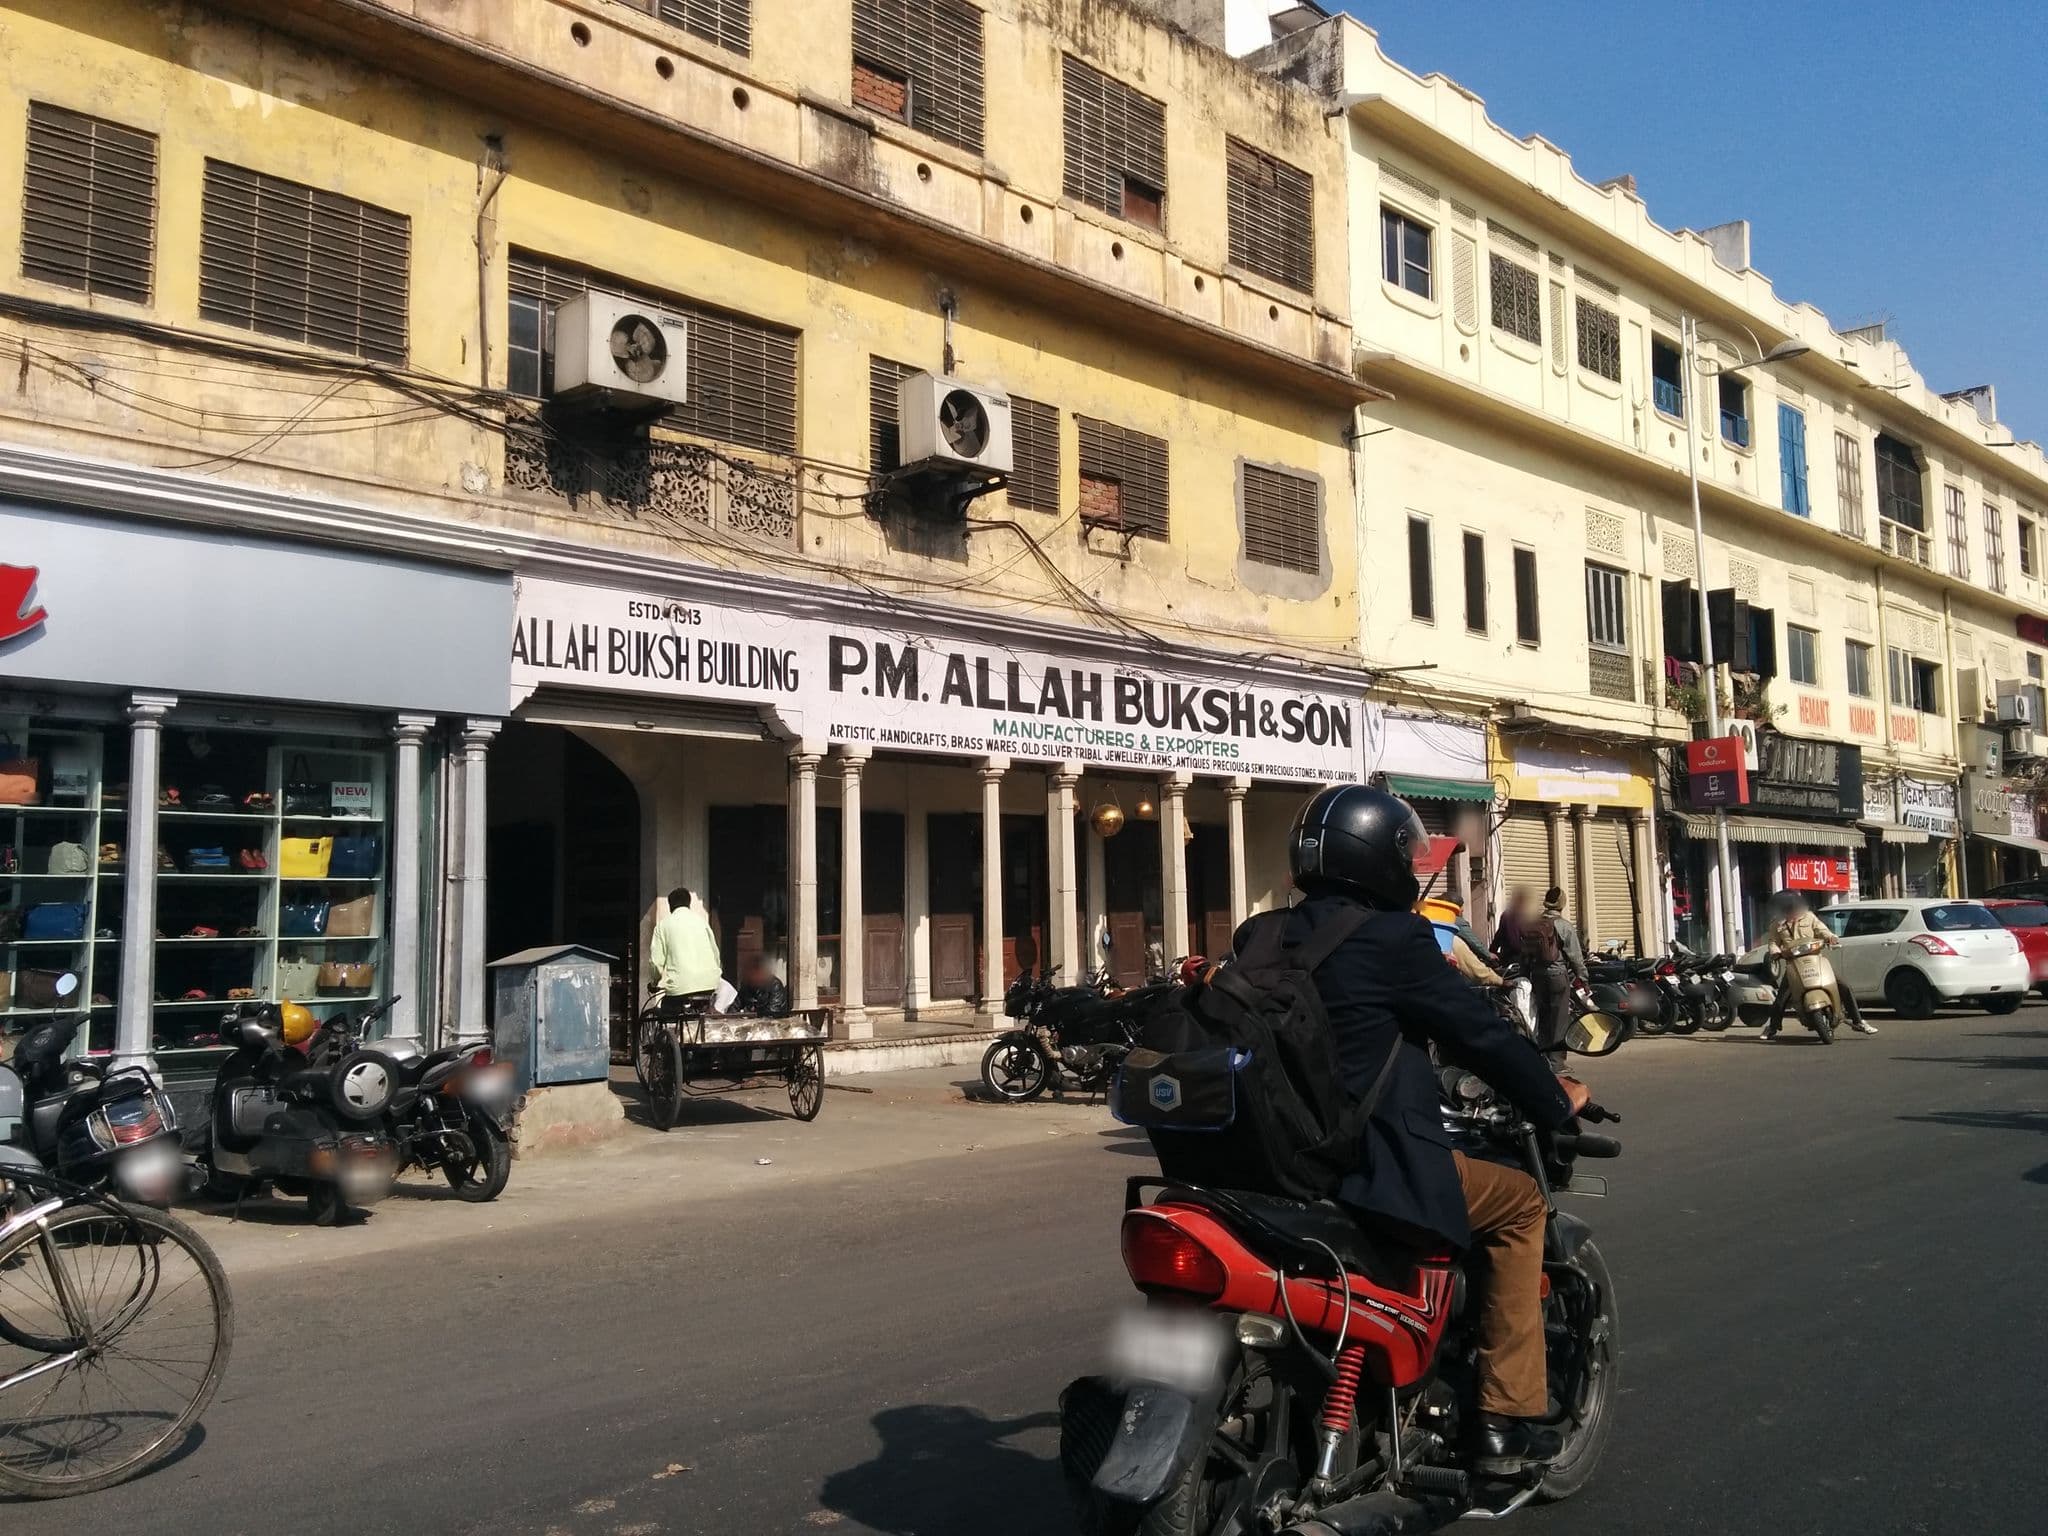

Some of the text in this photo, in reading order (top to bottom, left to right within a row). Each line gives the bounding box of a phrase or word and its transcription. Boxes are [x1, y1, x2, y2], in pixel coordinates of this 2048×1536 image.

[629, 601, 663, 620] ESTD.
[512, 616, 800, 692] ALLAH BUKSH BUILDING
[829, 635, 929, 702] P.M.
[940, 652, 1103, 722] ALLAH
[1281, 699, 1352, 748] SON
[1798, 695, 1917, 744] HEMANT KUMAR DUGAR
[993, 718, 1240, 758] MANUFACTURERS & EXPORTERS
[951, 735, 983, 750] BRASS
[1021, 742, 1040, 755] OLD
[1042, 744, 1073, 758] SILVER
[1074, 746, 1102, 760] TRIBAL
[1251, 762, 1265, 774] SEMI
[1265, 764, 1294, 777] PRECIOUS
[1318, 769, 1334, 781] WOOD
[1334, 771, 1358, 782] CARVING
[335, 786, 368, 796] NEW
[1909, 813, 1930, 831] DUGAR
[1789, 862, 1809, 881] SALE
[1814, 860, 1828, 886] 50
[1155, 1087, 1173, 1097] USV
